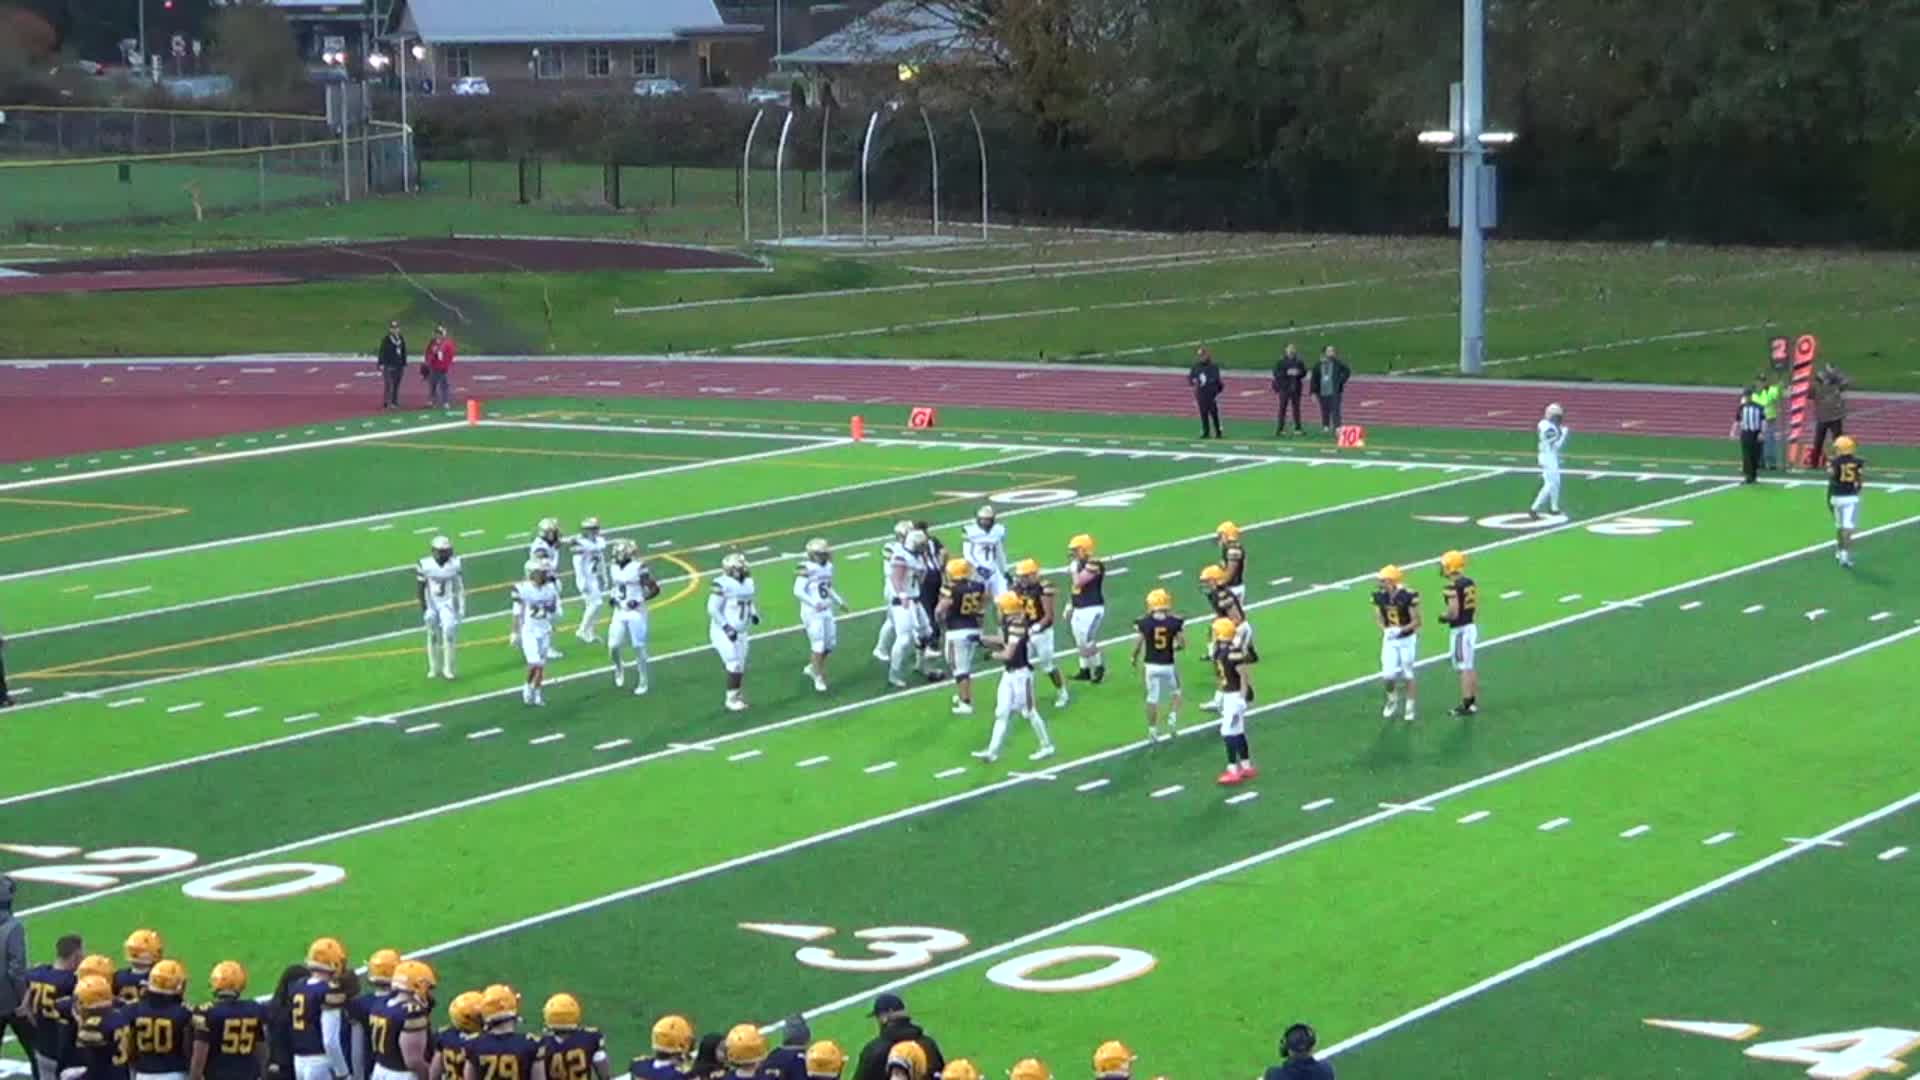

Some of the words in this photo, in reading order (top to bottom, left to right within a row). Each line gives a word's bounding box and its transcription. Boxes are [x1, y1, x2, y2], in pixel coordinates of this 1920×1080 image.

[1839, 463, 1857, 482] 15
[1154, 627, 1167, 650] 5
[3, 846, 346, 900] 20
[795, 926, 1159, 992] 30
[291, 995, 305, 1030] 2
[135, 1017, 173, 1053] 20
[221, 1018, 259, 1054] 55
[369, 1015, 388, 1055] 77
[1742, 1026, 1920, 1080] 4
